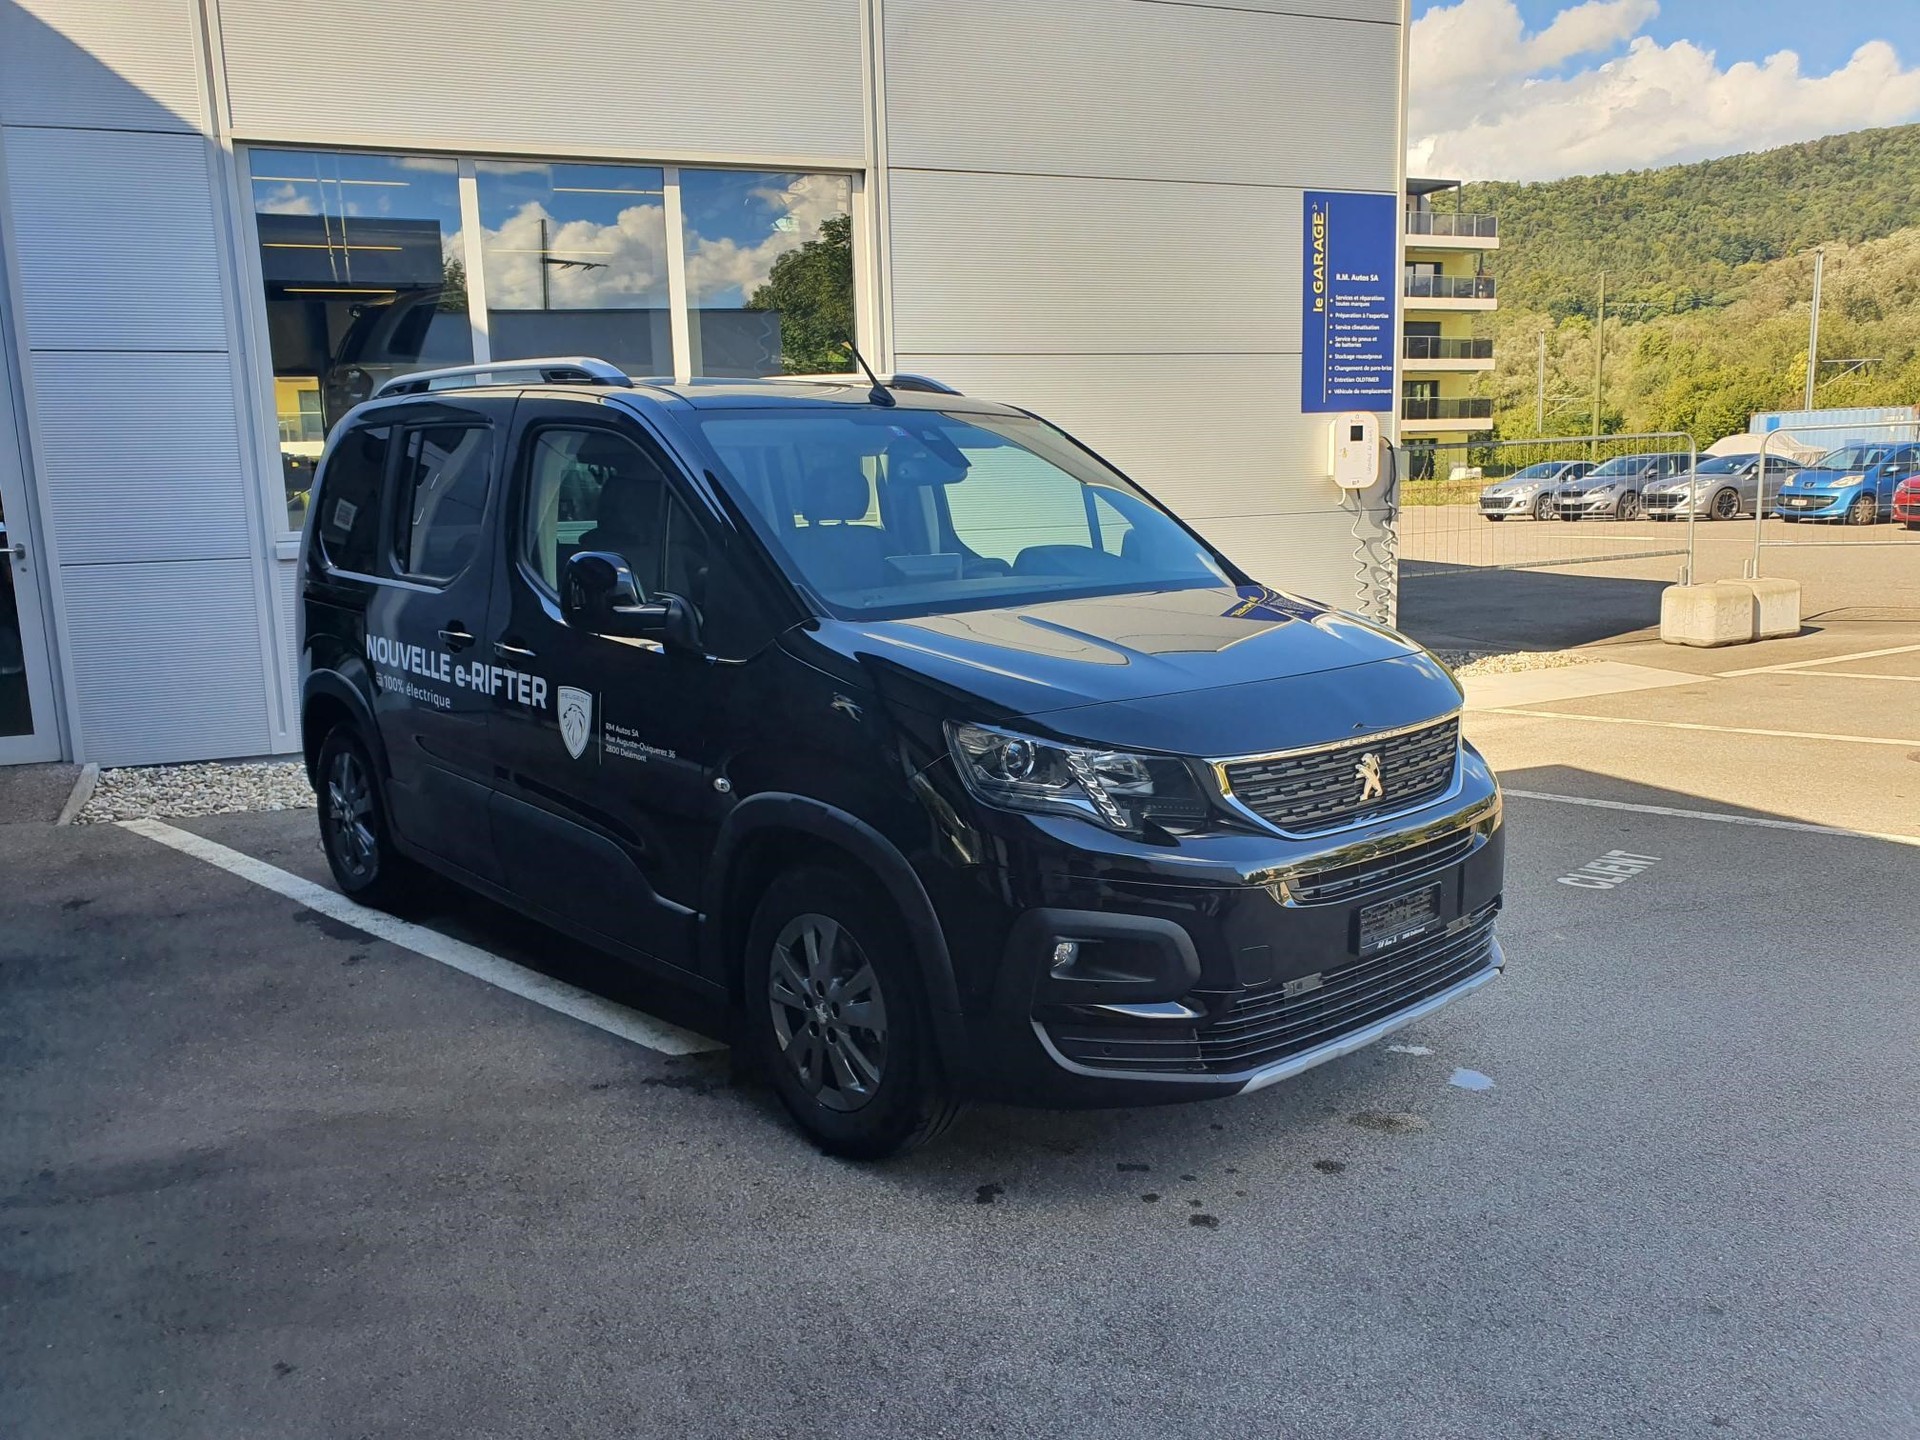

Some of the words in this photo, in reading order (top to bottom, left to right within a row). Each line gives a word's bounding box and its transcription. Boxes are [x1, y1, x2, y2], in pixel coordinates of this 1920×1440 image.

[1312, 212, 1324, 294] GARAGE
[1370, 274, 1379, 282] SA
[1312, 298, 1324, 312] le
[366, 633, 451, 683] NOUVELLE
[454, 661, 547, 709] e-RIFTER
[384, 674, 405, 694] 100%
[406, 682, 451, 709] électrique
[605, 733, 616, 743] Rue
[616, 725, 631, 736] Autos
[631, 728, 639, 737] SA
[1556, 849, 1662, 889] CLIENT
